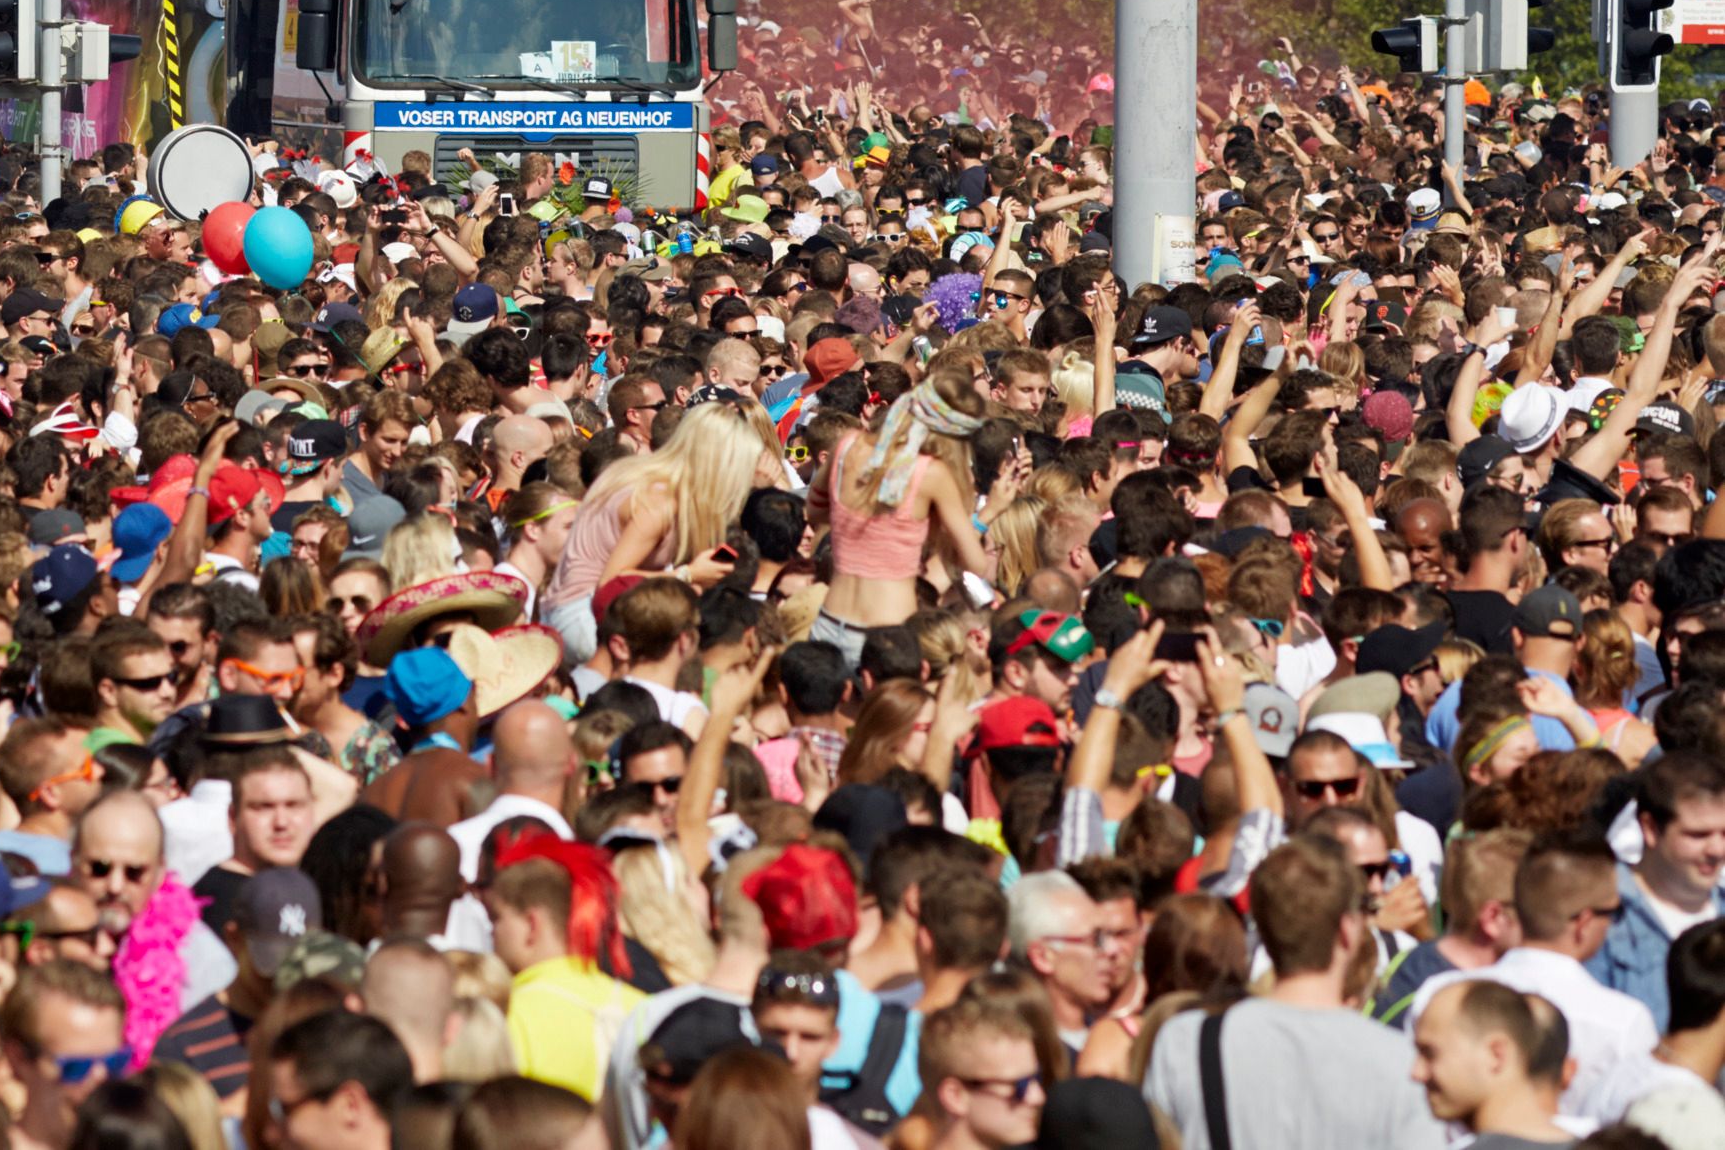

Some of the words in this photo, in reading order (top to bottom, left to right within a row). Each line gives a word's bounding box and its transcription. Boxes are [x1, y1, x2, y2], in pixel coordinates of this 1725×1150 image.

[559, 43, 584, 72] 15
[398, 110, 455, 126] VOSER
[458, 110, 556, 127] TRANSPORT
[560, 111, 583, 126] AG
[586, 110, 672, 126] NEUENHOF
[495, 152, 579, 169] MN
